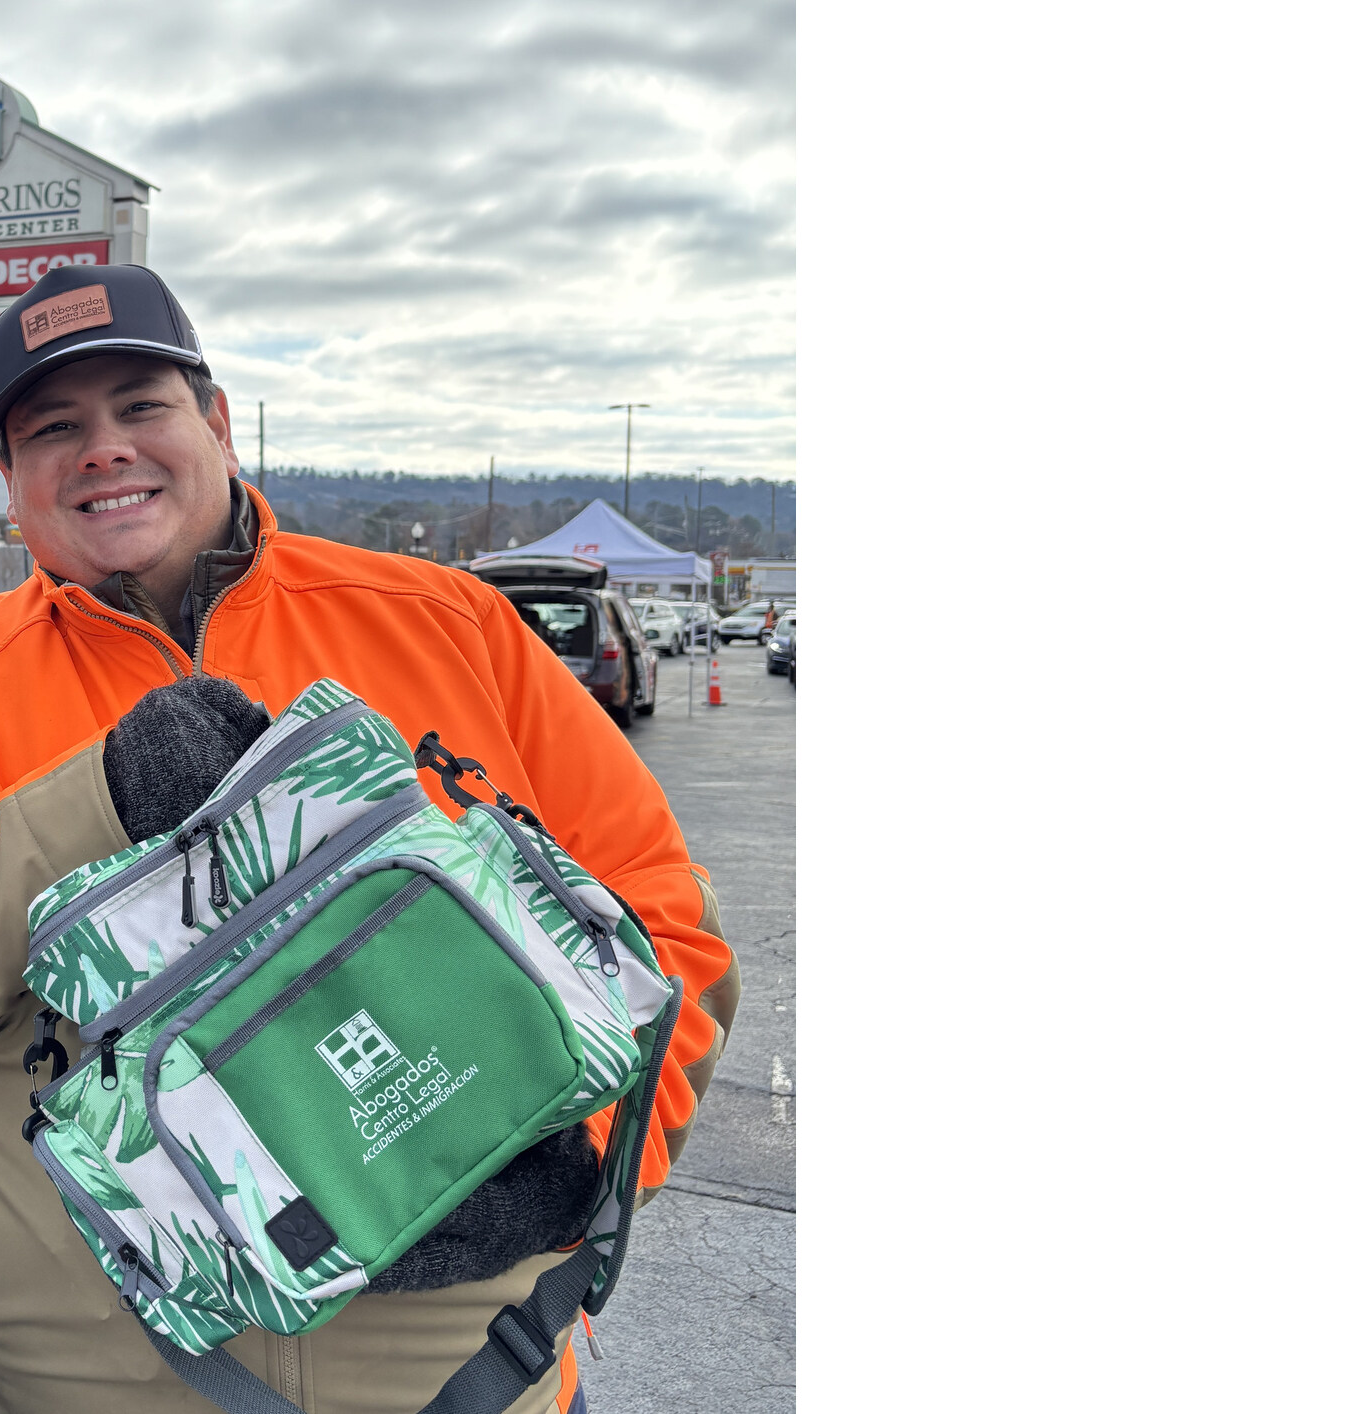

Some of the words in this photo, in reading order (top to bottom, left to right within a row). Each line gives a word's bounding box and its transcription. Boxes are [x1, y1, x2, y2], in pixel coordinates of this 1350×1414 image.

[50, 297, 104, 318] Abogados
[51, 312, 78, 324] Centro
[81, 302, 106, 315] Legal
[375, 1055, 408, 1082] Associates
[360, 1102, 409, 1140] Centro
[405, 1062, 452, 1105] Legal
[361, 1117, 414, 1166] ACCIDENTES
[412, 1112, 422, 1124] &
[419, 1063, 479, 1118] INMIGRACIÓN
